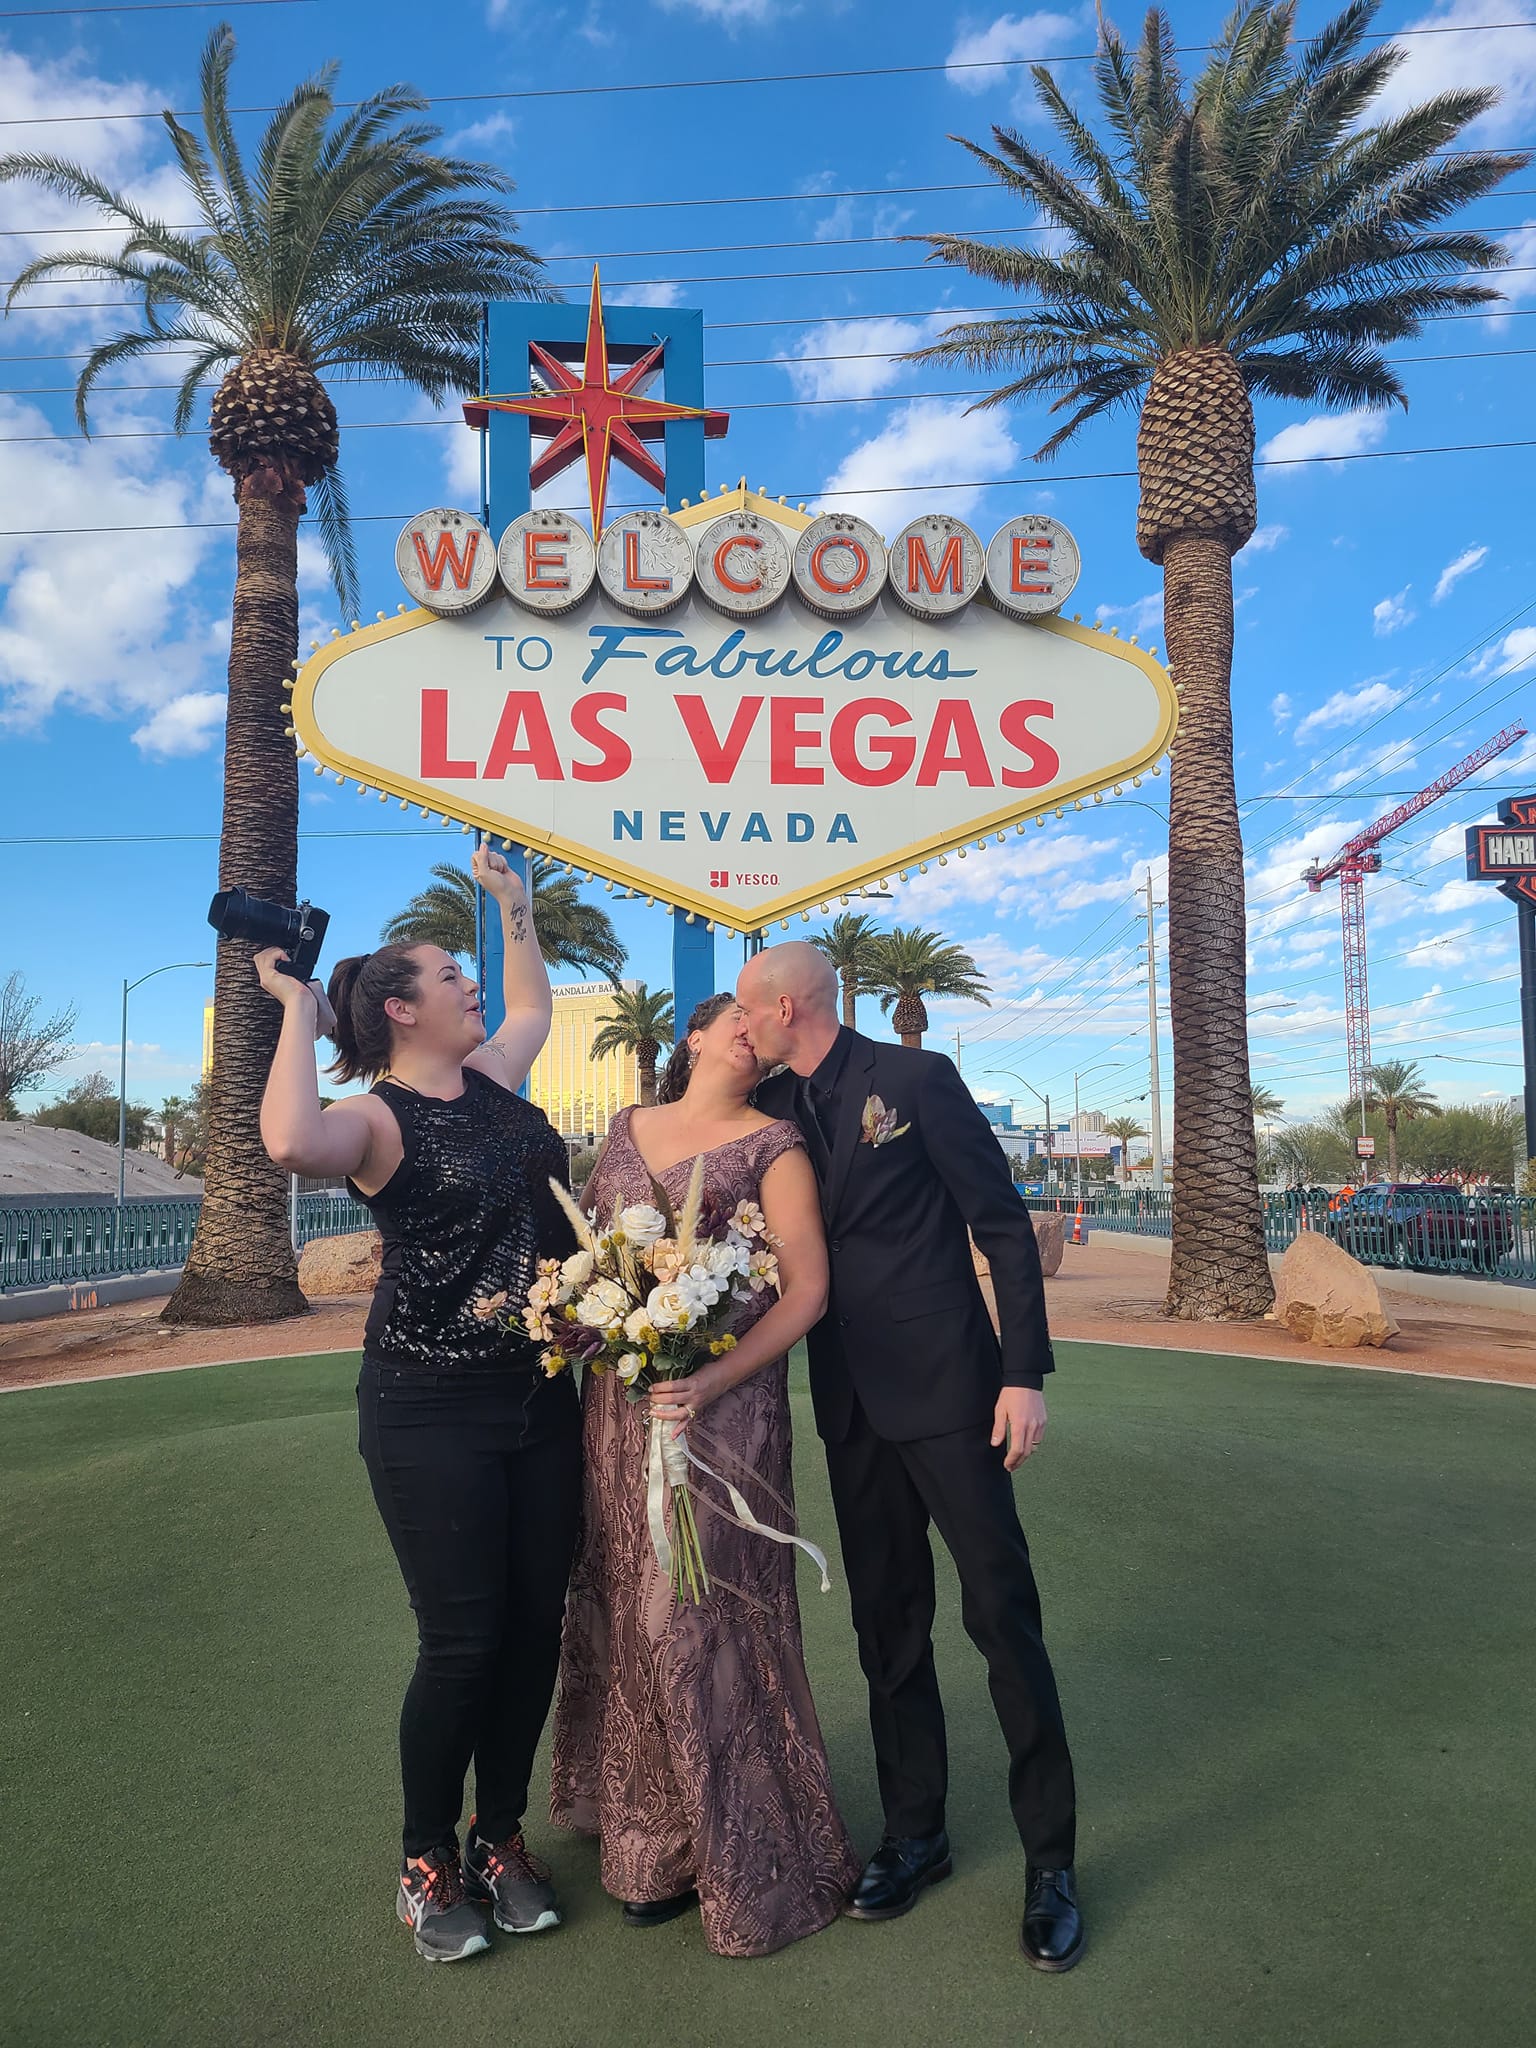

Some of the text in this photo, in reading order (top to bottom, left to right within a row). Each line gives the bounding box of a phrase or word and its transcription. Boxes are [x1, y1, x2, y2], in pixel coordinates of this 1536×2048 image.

[412, 530, 1055, 594] WELCOME
[483, 625, 979, 686] TO Fabulous
[420, 688, 1061, 789] LAS VEGAS
[612, 809, 859, 844] NEVADA
[735, 873, 778, 885] YESCO
[551, 983, 613, 997] MANDALAY BAY
